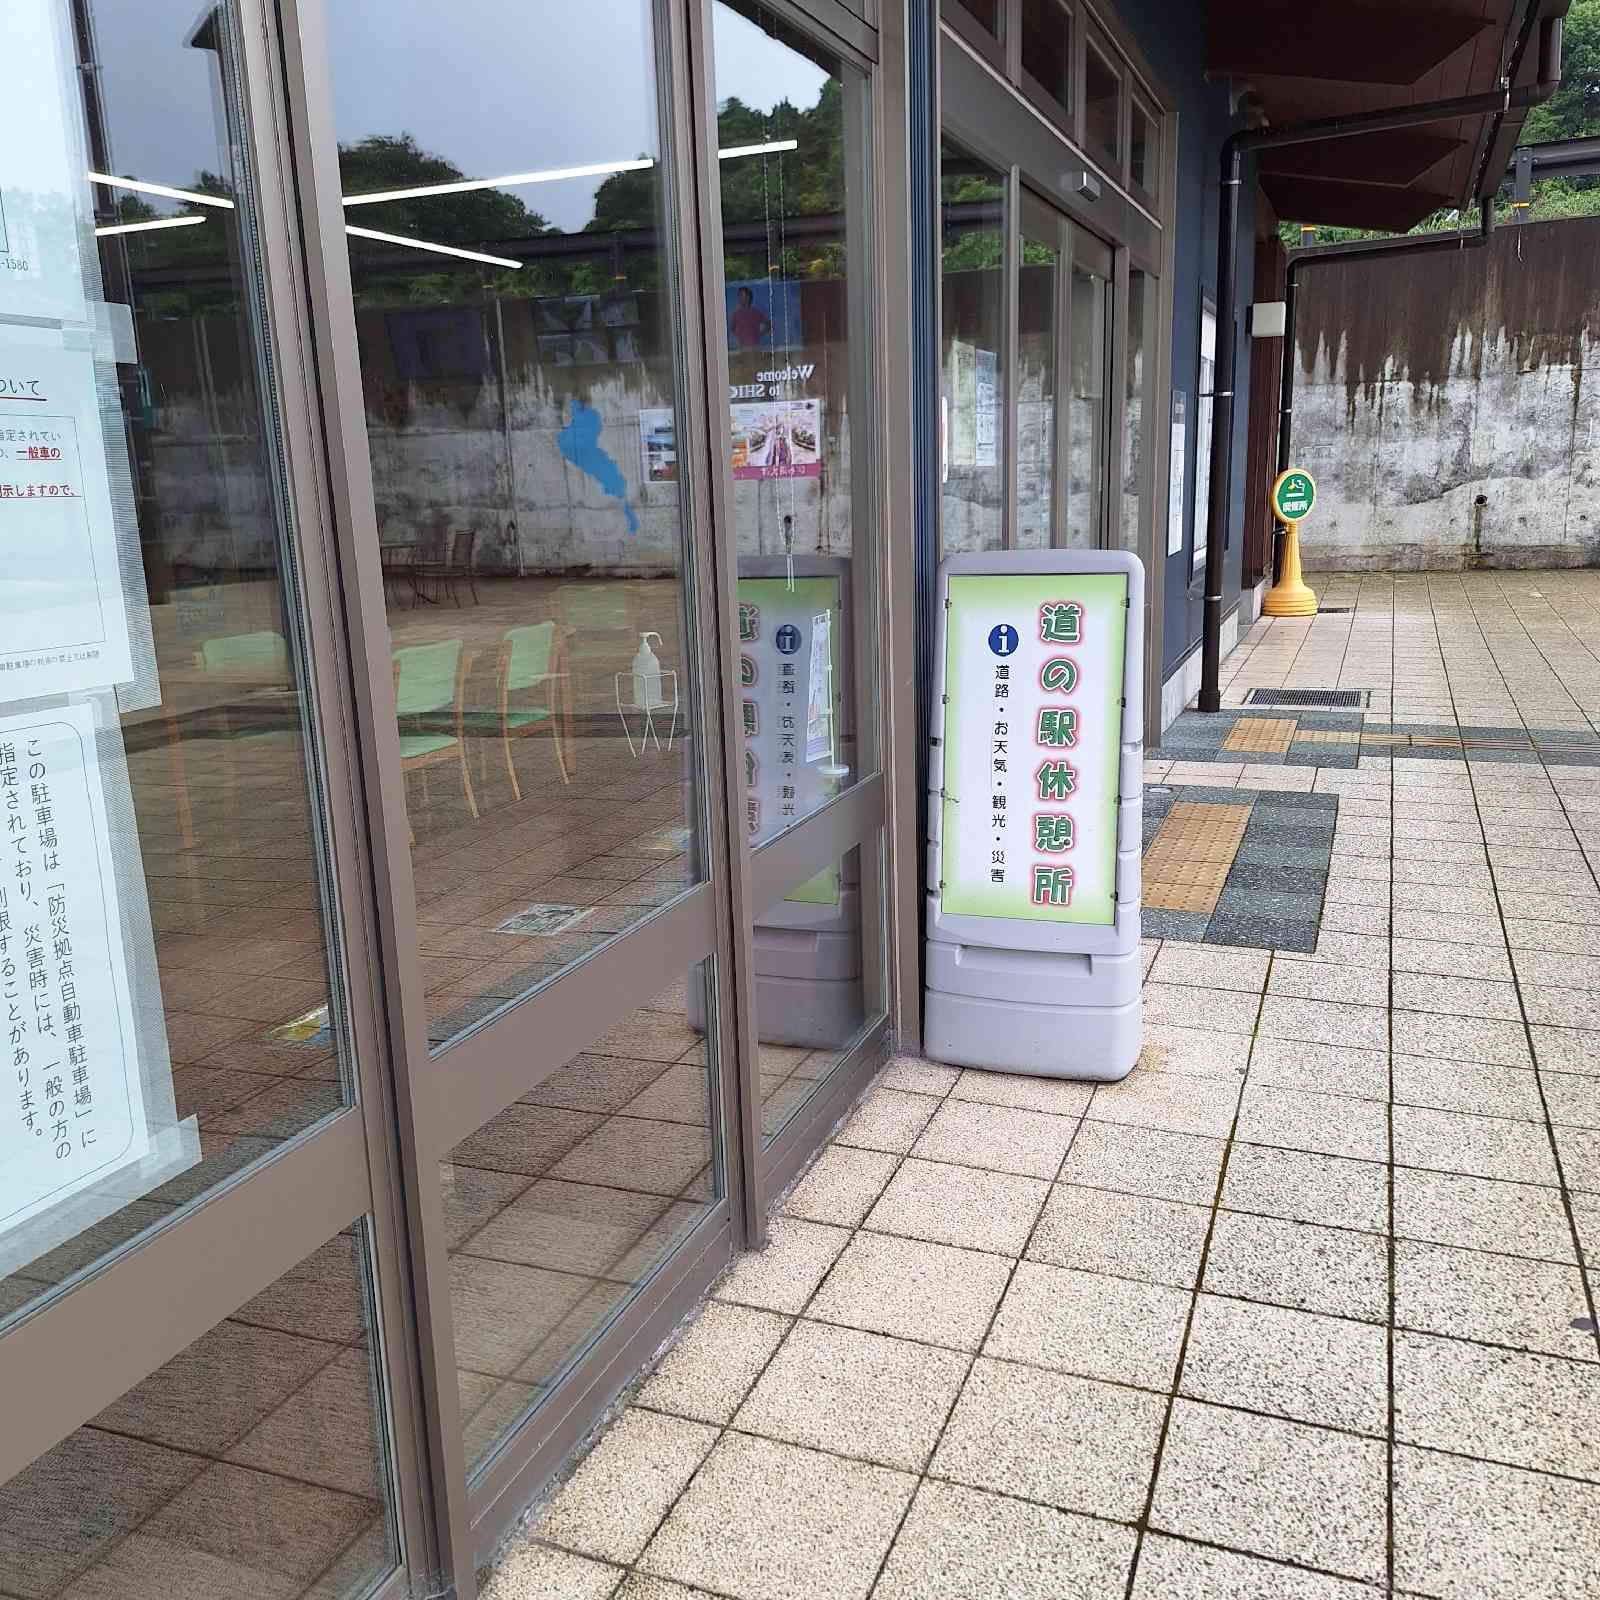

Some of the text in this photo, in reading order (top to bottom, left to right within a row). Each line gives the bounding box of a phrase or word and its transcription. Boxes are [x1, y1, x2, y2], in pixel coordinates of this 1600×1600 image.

[0, 484, 76, 497] 示しますので、
[1033, 604, 1080, 905] 道の駅休憩所
